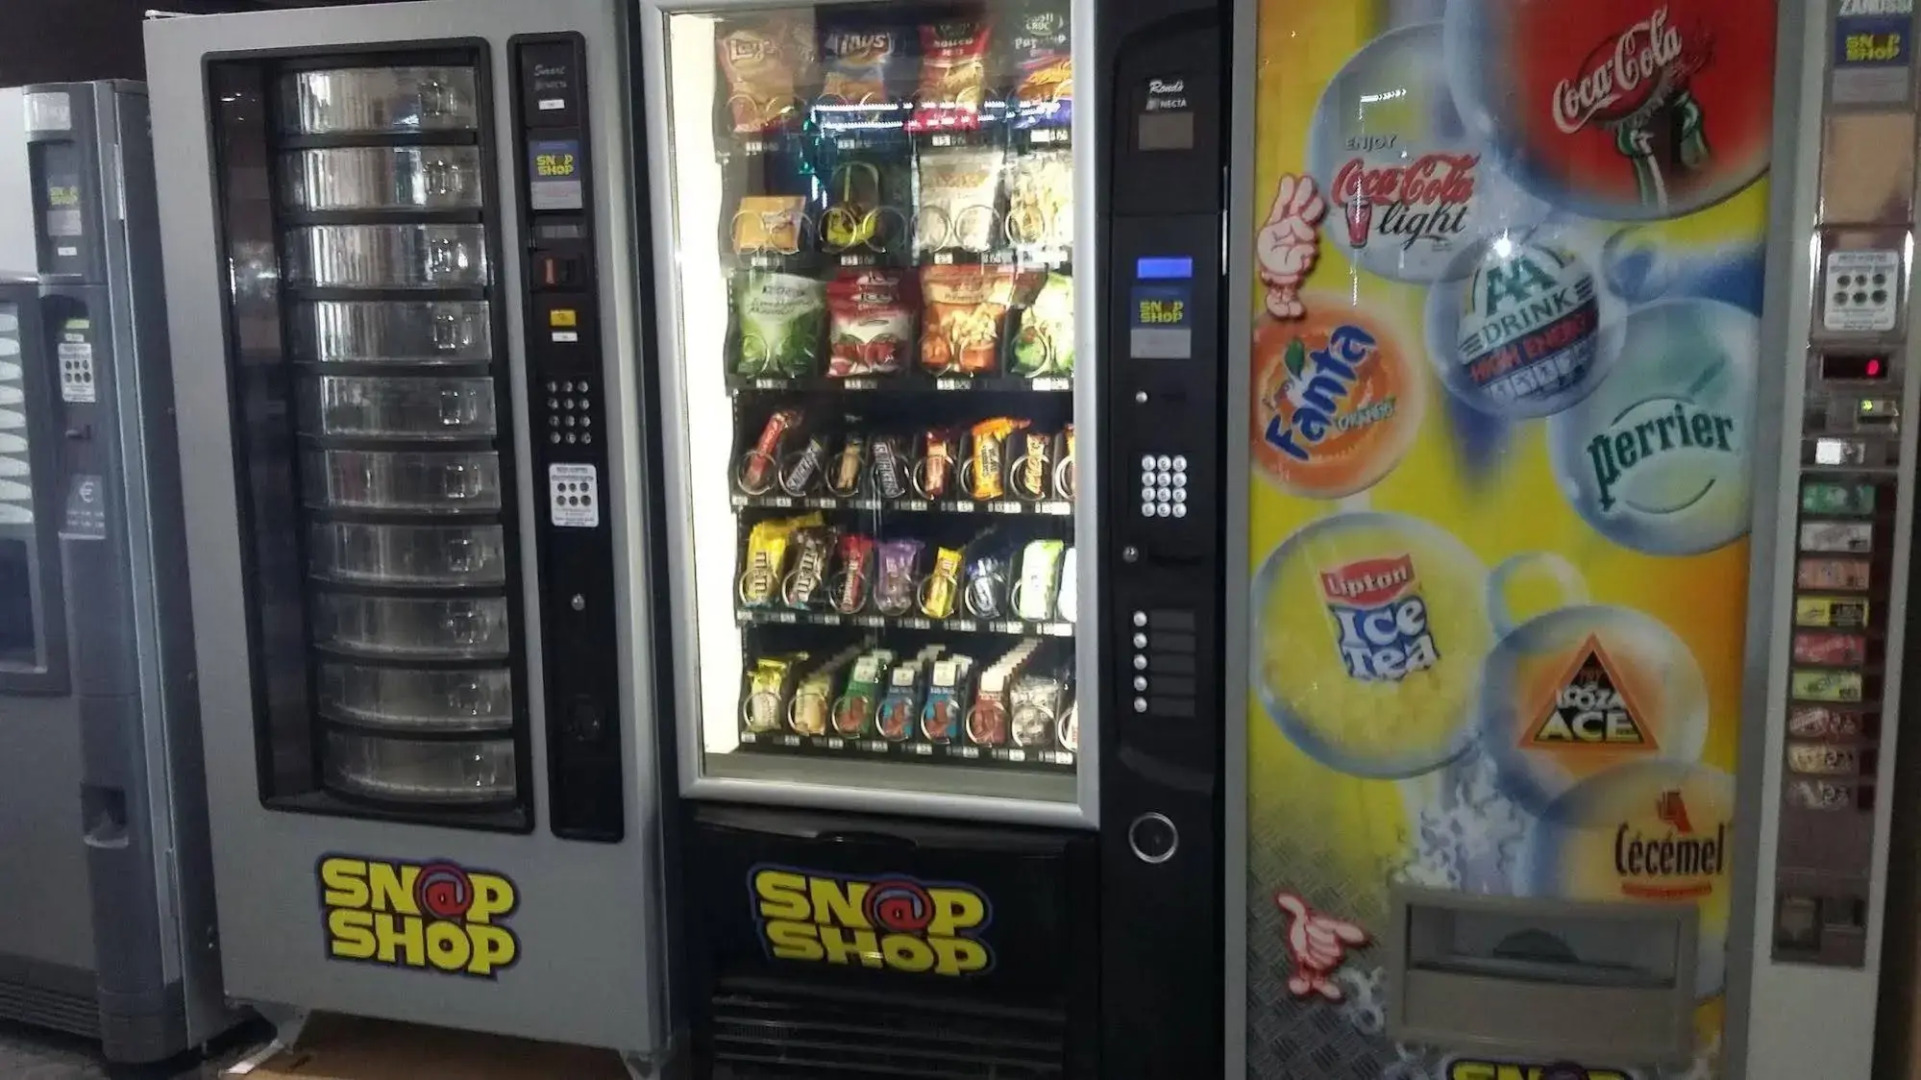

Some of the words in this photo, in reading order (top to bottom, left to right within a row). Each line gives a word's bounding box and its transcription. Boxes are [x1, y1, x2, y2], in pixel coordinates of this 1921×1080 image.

[1553, 4, 1683, 134] Coca-Cola
[1160, 98, 1187, 108] NECTA
[1345, 136, 1396, 151] ENJOY
[1377, 199, 1468, 250] light
[1482, 286, 1576, 346] DRINK
[1265, 325, 1376, 461] Fanta
[1587, 403, 1734, 512] perrier
[1328, 566, 1408, 598] Lipton
[1538, 711, 1640, 741] ACE
[1614, 821, 1725, 877] Cécémel
[329, 908, 515, 976] SHOP
[766, 920, 988, 976] SHOP
